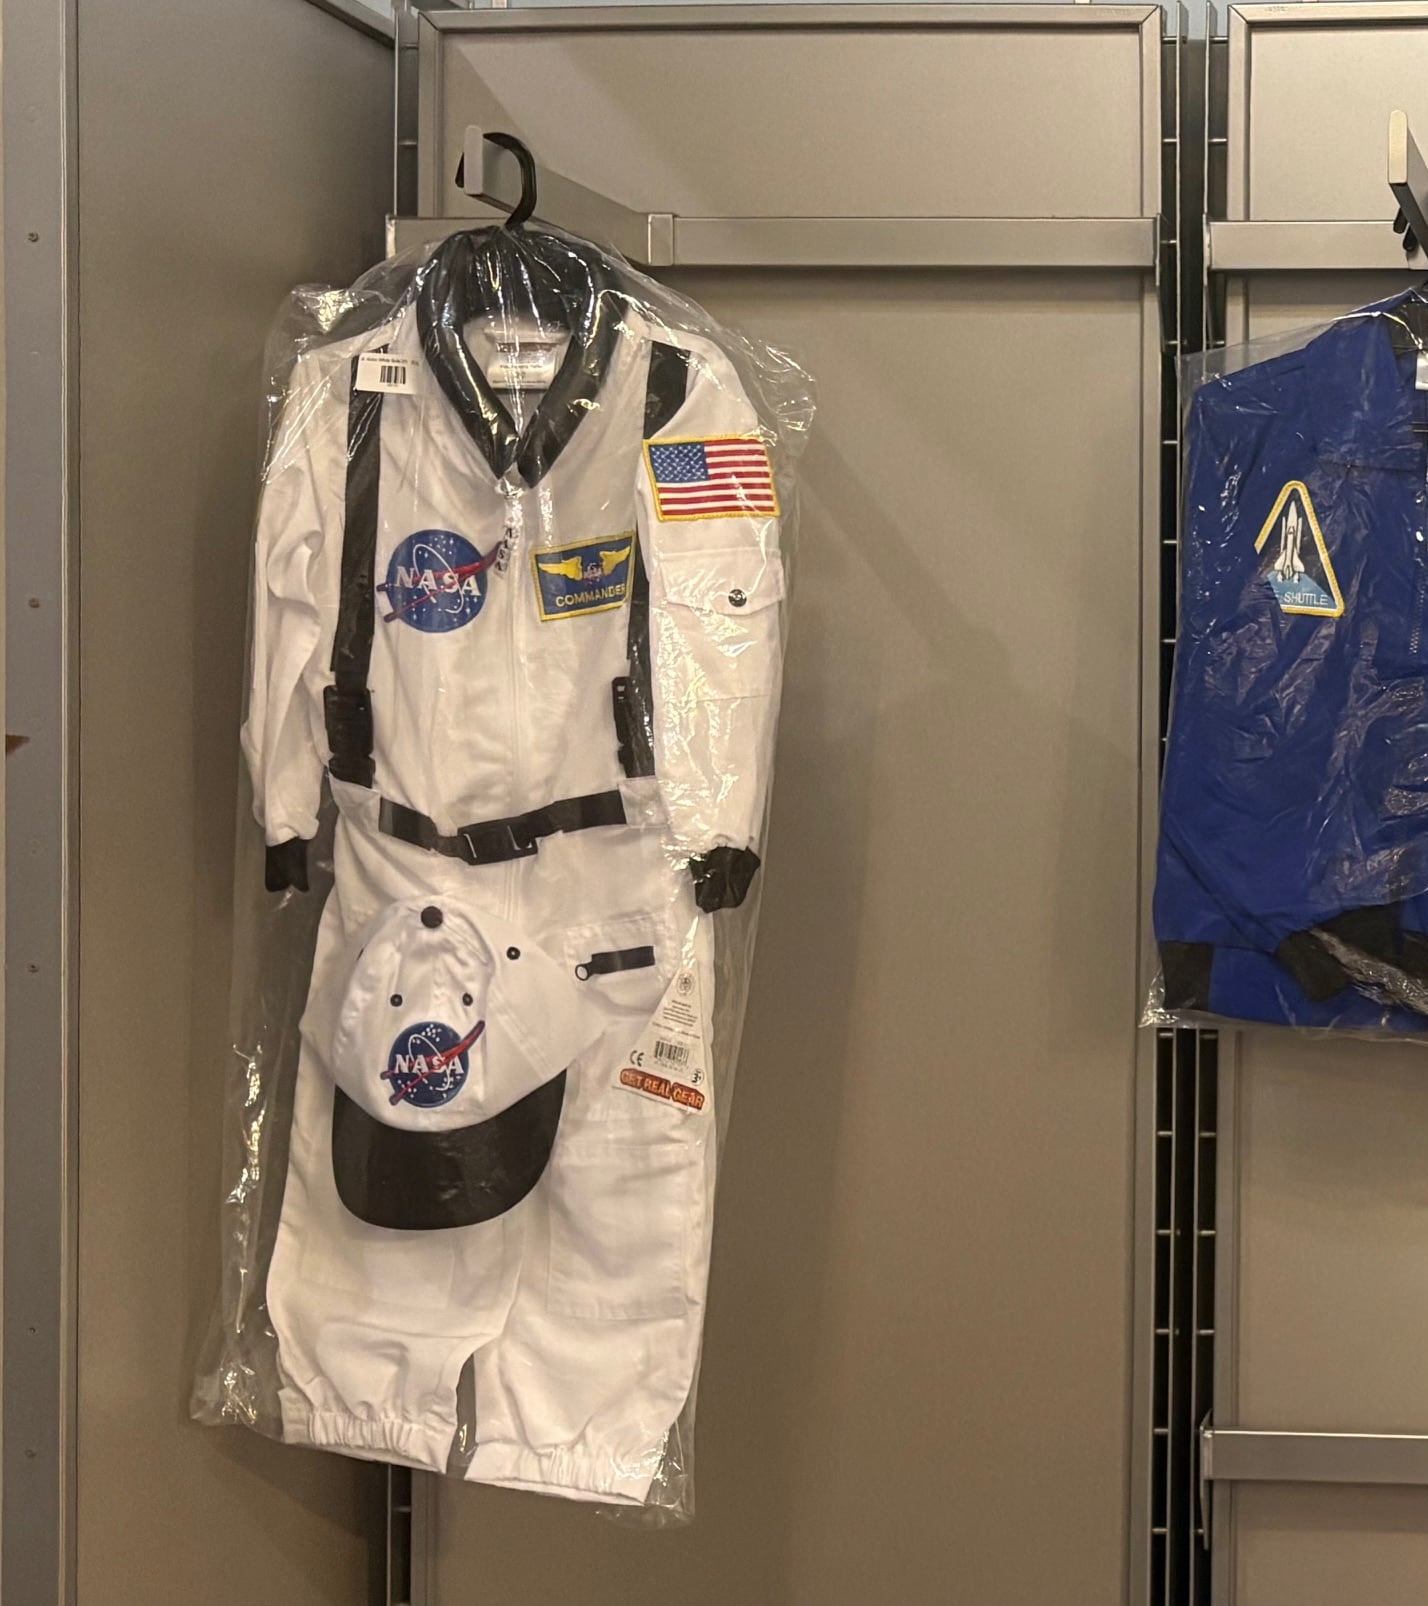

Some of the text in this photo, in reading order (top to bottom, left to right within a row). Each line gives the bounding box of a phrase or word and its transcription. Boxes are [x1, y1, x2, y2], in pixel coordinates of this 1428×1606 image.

[396, 566, 481, 597] NASA
[1284, 592, 1329, 606] SHUTTLE
[395, 1053, 464, 1075] NASA
[621, 1070, 704, 1110] GET REAL GEAR
